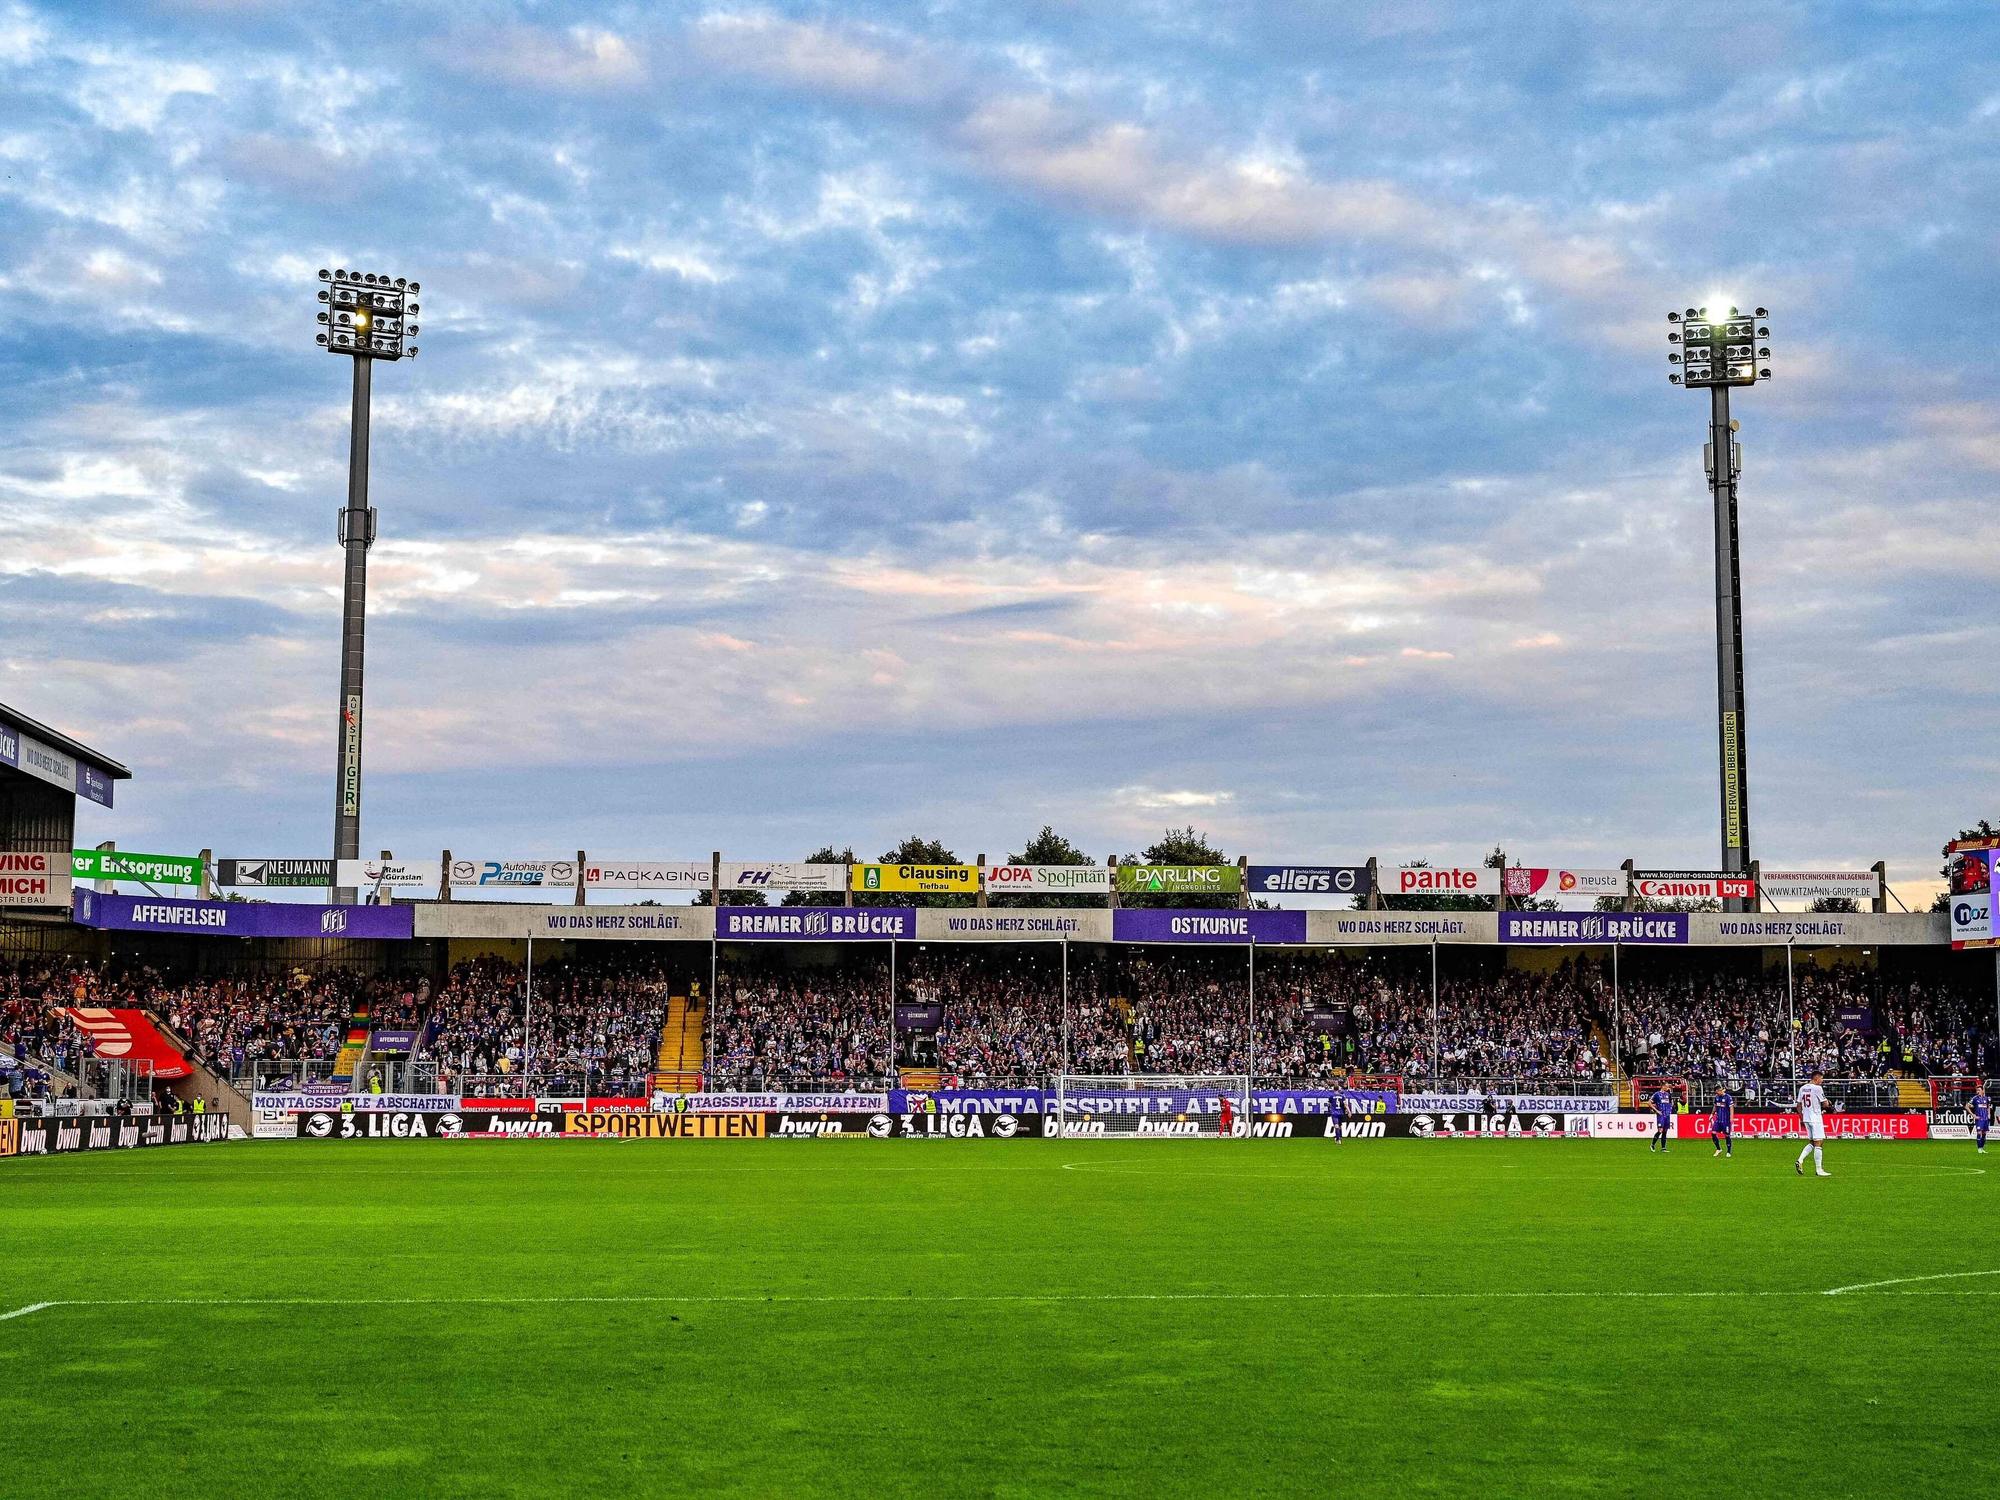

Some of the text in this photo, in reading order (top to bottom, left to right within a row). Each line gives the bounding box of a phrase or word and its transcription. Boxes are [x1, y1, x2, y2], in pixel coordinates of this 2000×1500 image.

[1725, 713, 1738, 837] KLETTERWALD IBBENBÜREN
[73, 855, 193, 882] er Entsorgung
[269, 861, 330, 875] NEUMANN
[479, 862, 545, 886] Prange
[502, 862, 547, 871] Autohaus
[899, 866, 969, 883] Clausing
[988, 867, 1033, 882] JOPA
[269, 876, 291, 886] ZELTE
[300, 876, 330, 886] PLANEN
[604, 870, 709, 881] PACKAGING
[737, 871, 772, 885] FH
[1136, 868, 1221, 884] DARLING
[1264, 869, 1331, 891] ellers
[1400, 867, 1478, 893] pante
[1580, 875, 1618, 887] neusta
[1639, 871, 1748, 881] www.kopierer-osnabrueck.de
[1763, 872, 1874, 881] VERFAHRENSTECHNISCHER ANLAGENBAU
[919, 882, 949, 890] Tiefbau
[1640, 880, 1713, 897] Canon
[1722, 881, 1749, 898] brg
[1768, 885, 1871, 897] WWW.KITZMANN-GRUPPE.DE
[132, 903, 227, 927] AFFENFELSEN
[548, 912, 684, 930] WO DAS HERZ SCHLÄGT.
[1960, 907, 1989, 921] noz
[729, 915, 802, 934] BREMER
[832, 911, 904, 935] BRÜCKE
[948, 915, 1081, 932] WO DAS HERZ SCHLÄGT.
[1171, 916, 1249, 935] OSTKURVE
[1338, 918, 1467, 935] WO DAS HERZ SCHLÄGT.
[1509, 920, 1578, 937] BREMER
[1607, 916, 1677, 938] BRÜCKE
[1719, 919, 1847, 936] WO DAS HERZ SCHLÄGT.
[255, 1097, 454, 1110] MONTAGSSPILE ABSCHAFFEN!
[593, 1104, 647, 1113] so-tech.eu
[662, 1096, 778, 1110] MNTAGSSPIELE
[784, 1096, 882, 1109] ABSCHAFFEN!
[1185, 1098, 1375, 1114] ABSCHAFFN!
[1401, 1098, 1611, 1112] MONTAGSSPLE ABSCHAFFEN!
[1802, 1094, 1811, 1107] 15
[340, 1113, 429, 1138] 3. LIGA
[488, 1113, 554, 1134] bwin
[573, 1114, 758, 1137] SPORTWETTEN
[779, 1114, 844, 1135] bwin
[927, 1114, 986, 1138] LIGA
[1044, 1114, 1106, 1138] bwin
[1137, 1114, 1201, 1134] bwin
[1324, 1114, 1386, 1138] bwin
[1925, 1109, 1976, 1126] Herforde
[55, 1118, 81, 1150] bwin
[88, 1117, 111, 1149] bwin
[117, 1117, 139, 1147] bwin
[1597, 1119, 1675, 1134] SCHLÜTR
[0, 1120, 15, 1153] EN
[20, 1119, 47, 1153] bwin
